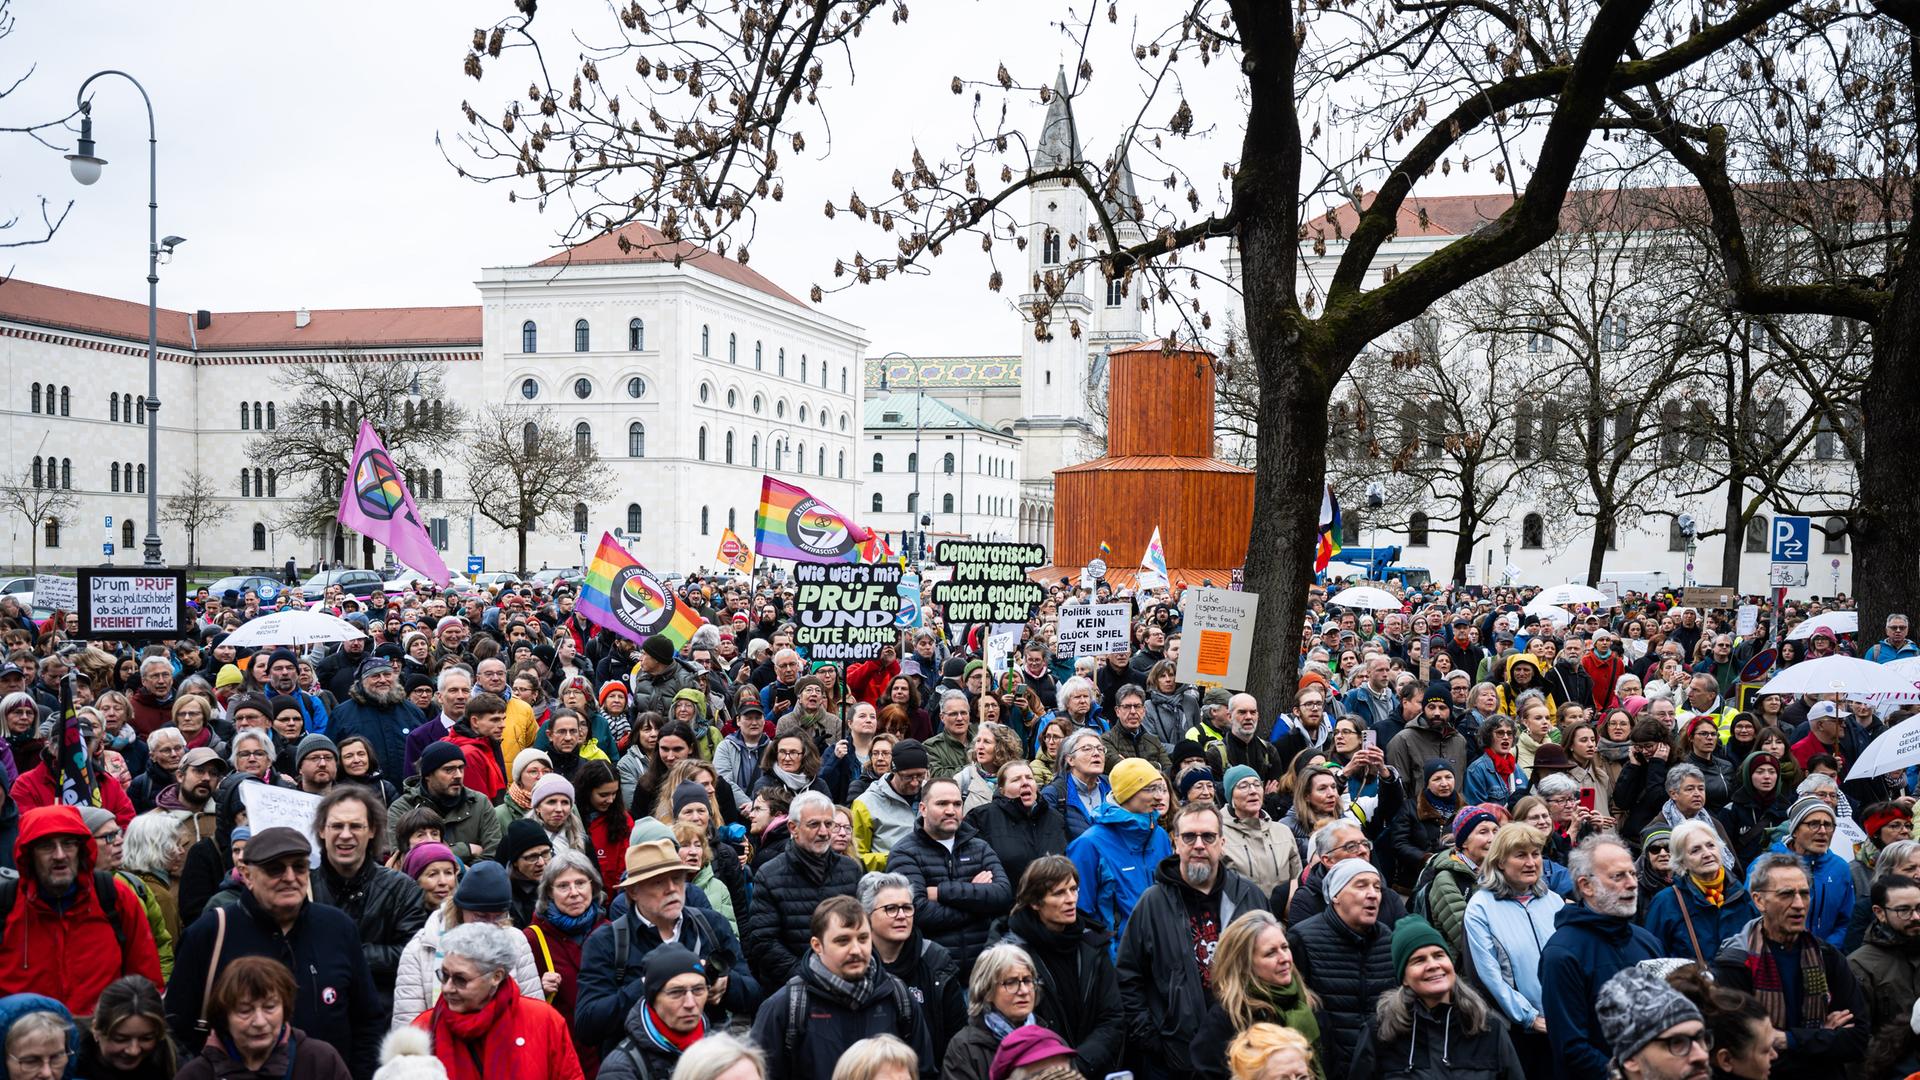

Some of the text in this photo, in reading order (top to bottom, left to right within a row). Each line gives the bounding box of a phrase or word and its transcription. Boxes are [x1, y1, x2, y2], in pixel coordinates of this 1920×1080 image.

[1776, 521, 1794, 555] P
[799, 543, 840, 555] ANTIFASCISTE
[940, 543, 1042, 564] Demokratische
[623, 568, 656, 582] EXTINCTION
[798, 565, 900, 583] Wie wär's mit
[957, 562, 1024, 582] Parteien,
[136, 578, 174, 590] PRÜF
[109, 594, 122, 603] sich
[124, 592, 154, 605] politisch
[155, 592, 174, 603] bindet
[936, 584, 1042, 602] macht endlich
[1195, 590, 1219, 603] Take
[97, 604, 170, 615] ob sich dann noch
[949, 602, 1030, 620] euren Job!
[1062, 607, 1091, 616] Politik
[1196, 604, 1245, 617] responsibility
[94, 616, 174, 628] FREIHEIT findet
[616, 608, 650, 632] ANTIFASCISTE
[801, 610, 894, 628] UND
[1077, 618, 1105, 628] KEIN
[1220, 615, 1237, 623] face
[796, 628, 896, 644] GUTE Politik
[1060, 630, 1123, 640] GLÜCK SPIEL
[812, 642, 882, 658] machen?
[1058, 643, 1075, 652] PRÜF
[1080, 644, 1102, 652] SEIN
